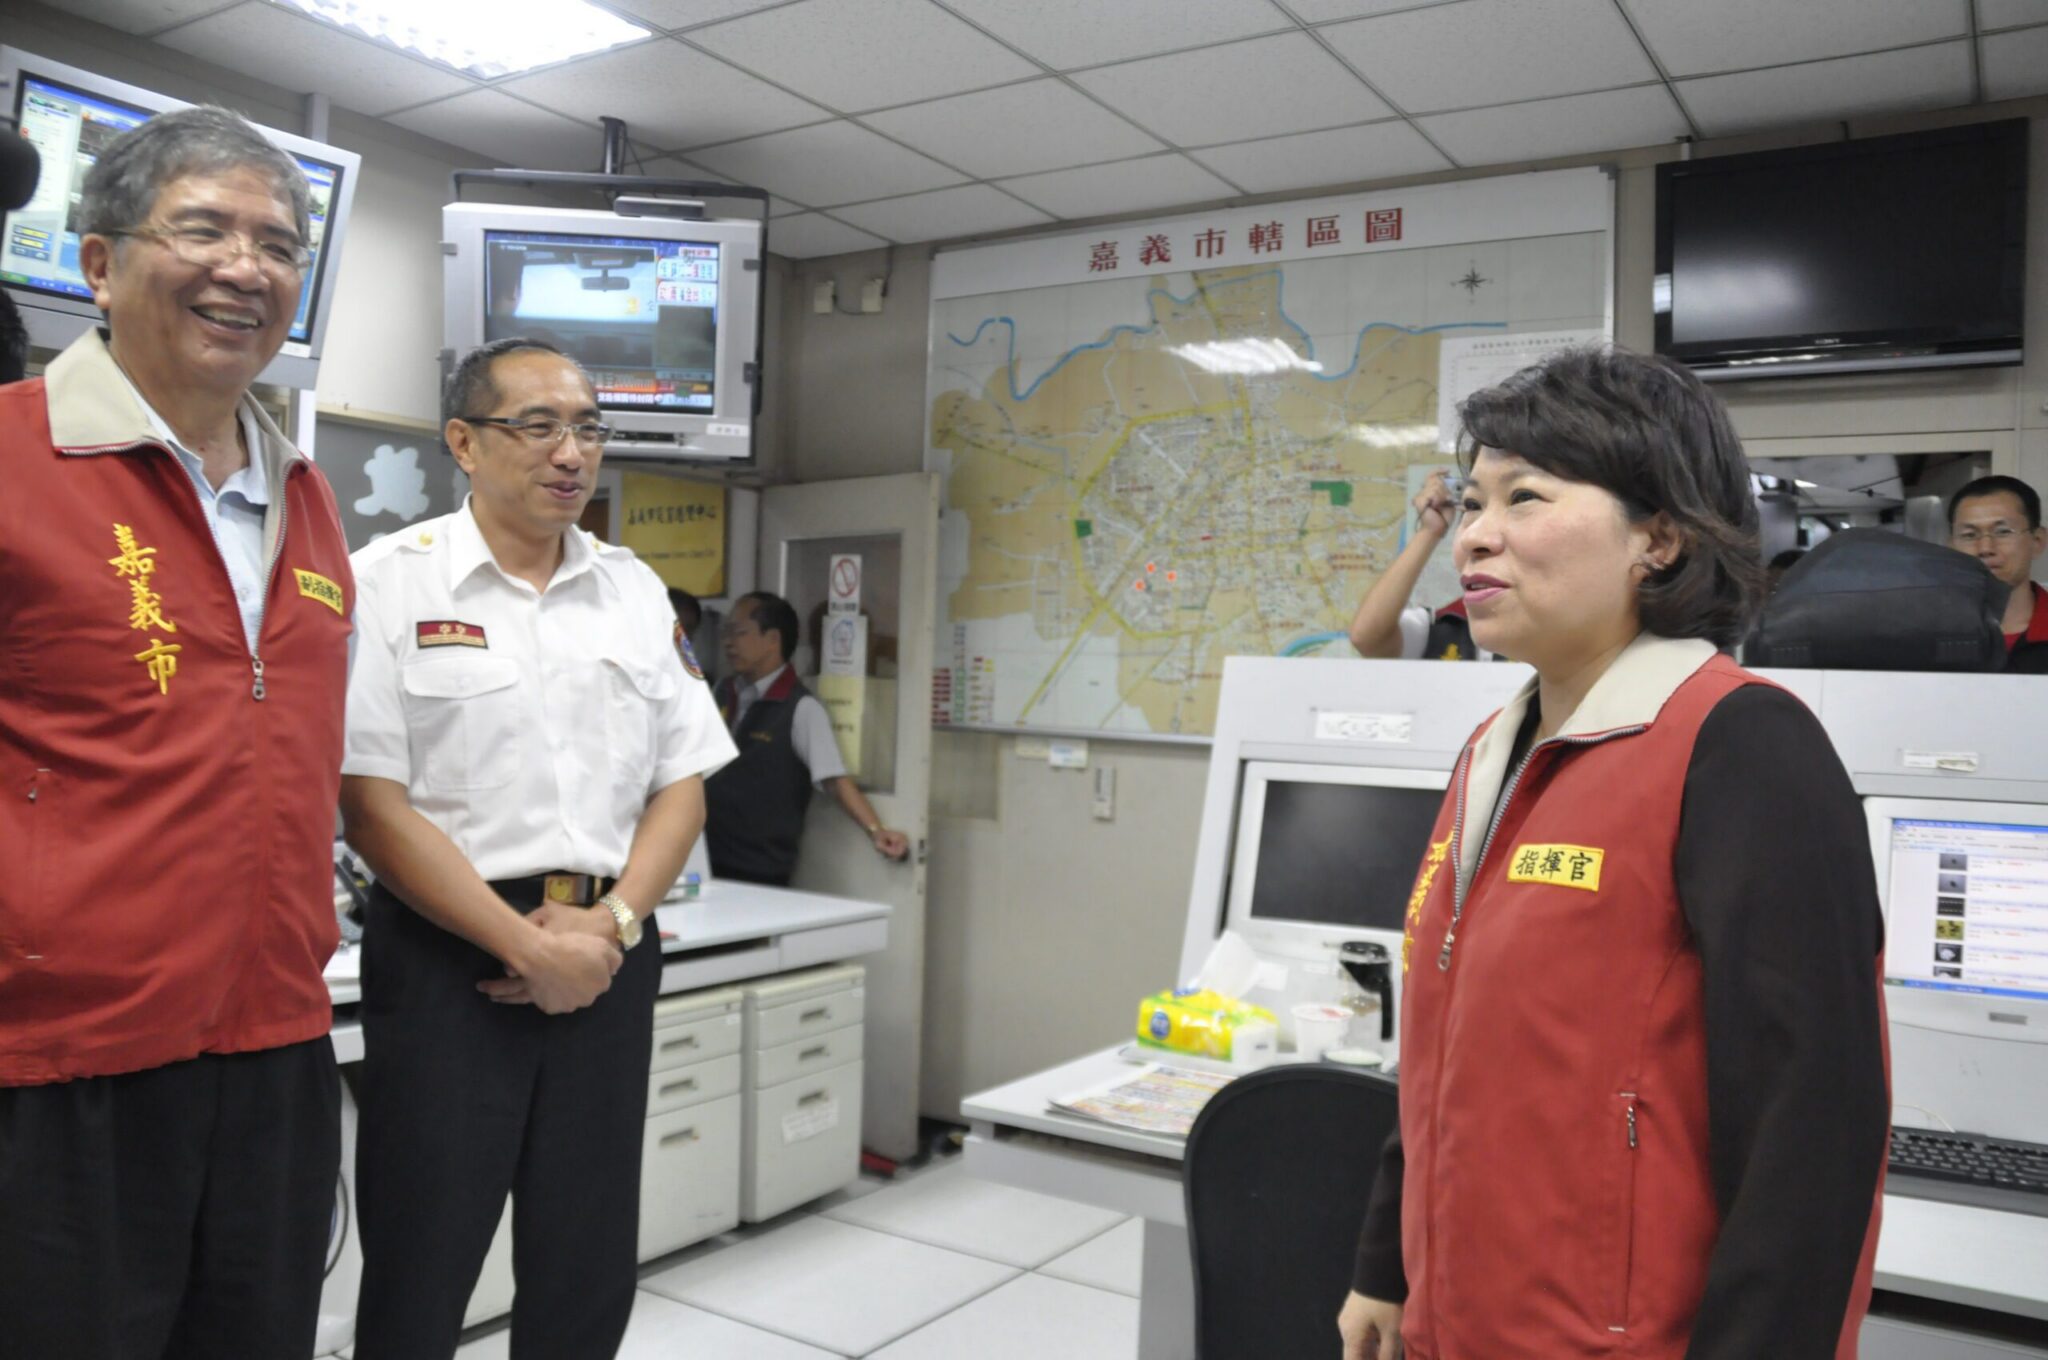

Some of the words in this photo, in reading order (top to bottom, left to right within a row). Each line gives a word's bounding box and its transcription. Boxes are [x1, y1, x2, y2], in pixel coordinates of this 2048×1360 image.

[1088, 208, 1403, 272] 嘉義市轄區圖
[108, 523, 182, 696] 嘉義市
[1515, 848, 1594, 882] 指揮官
